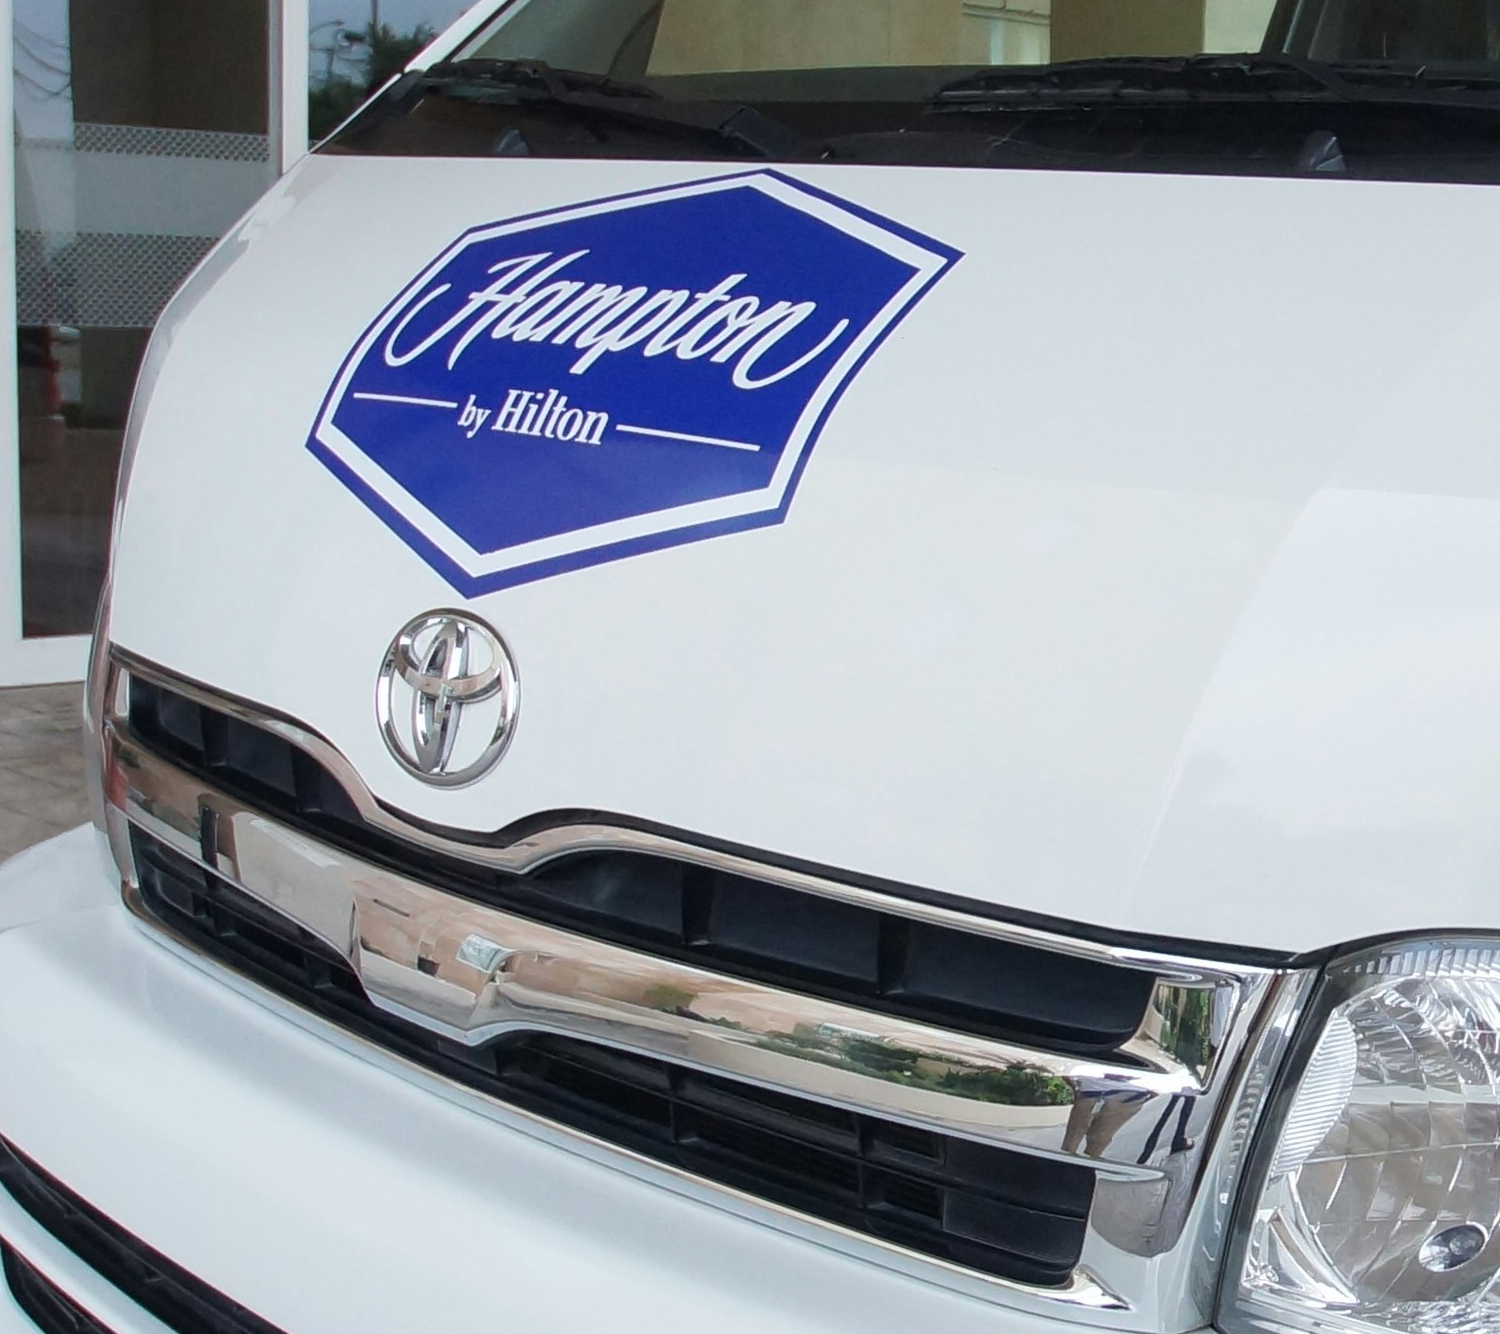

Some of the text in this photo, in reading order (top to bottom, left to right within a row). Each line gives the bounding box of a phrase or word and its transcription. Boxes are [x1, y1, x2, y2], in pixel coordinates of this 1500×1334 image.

[384, 248, 849, 390] Hampton
[457, 388, 609, 445] by Hilton
